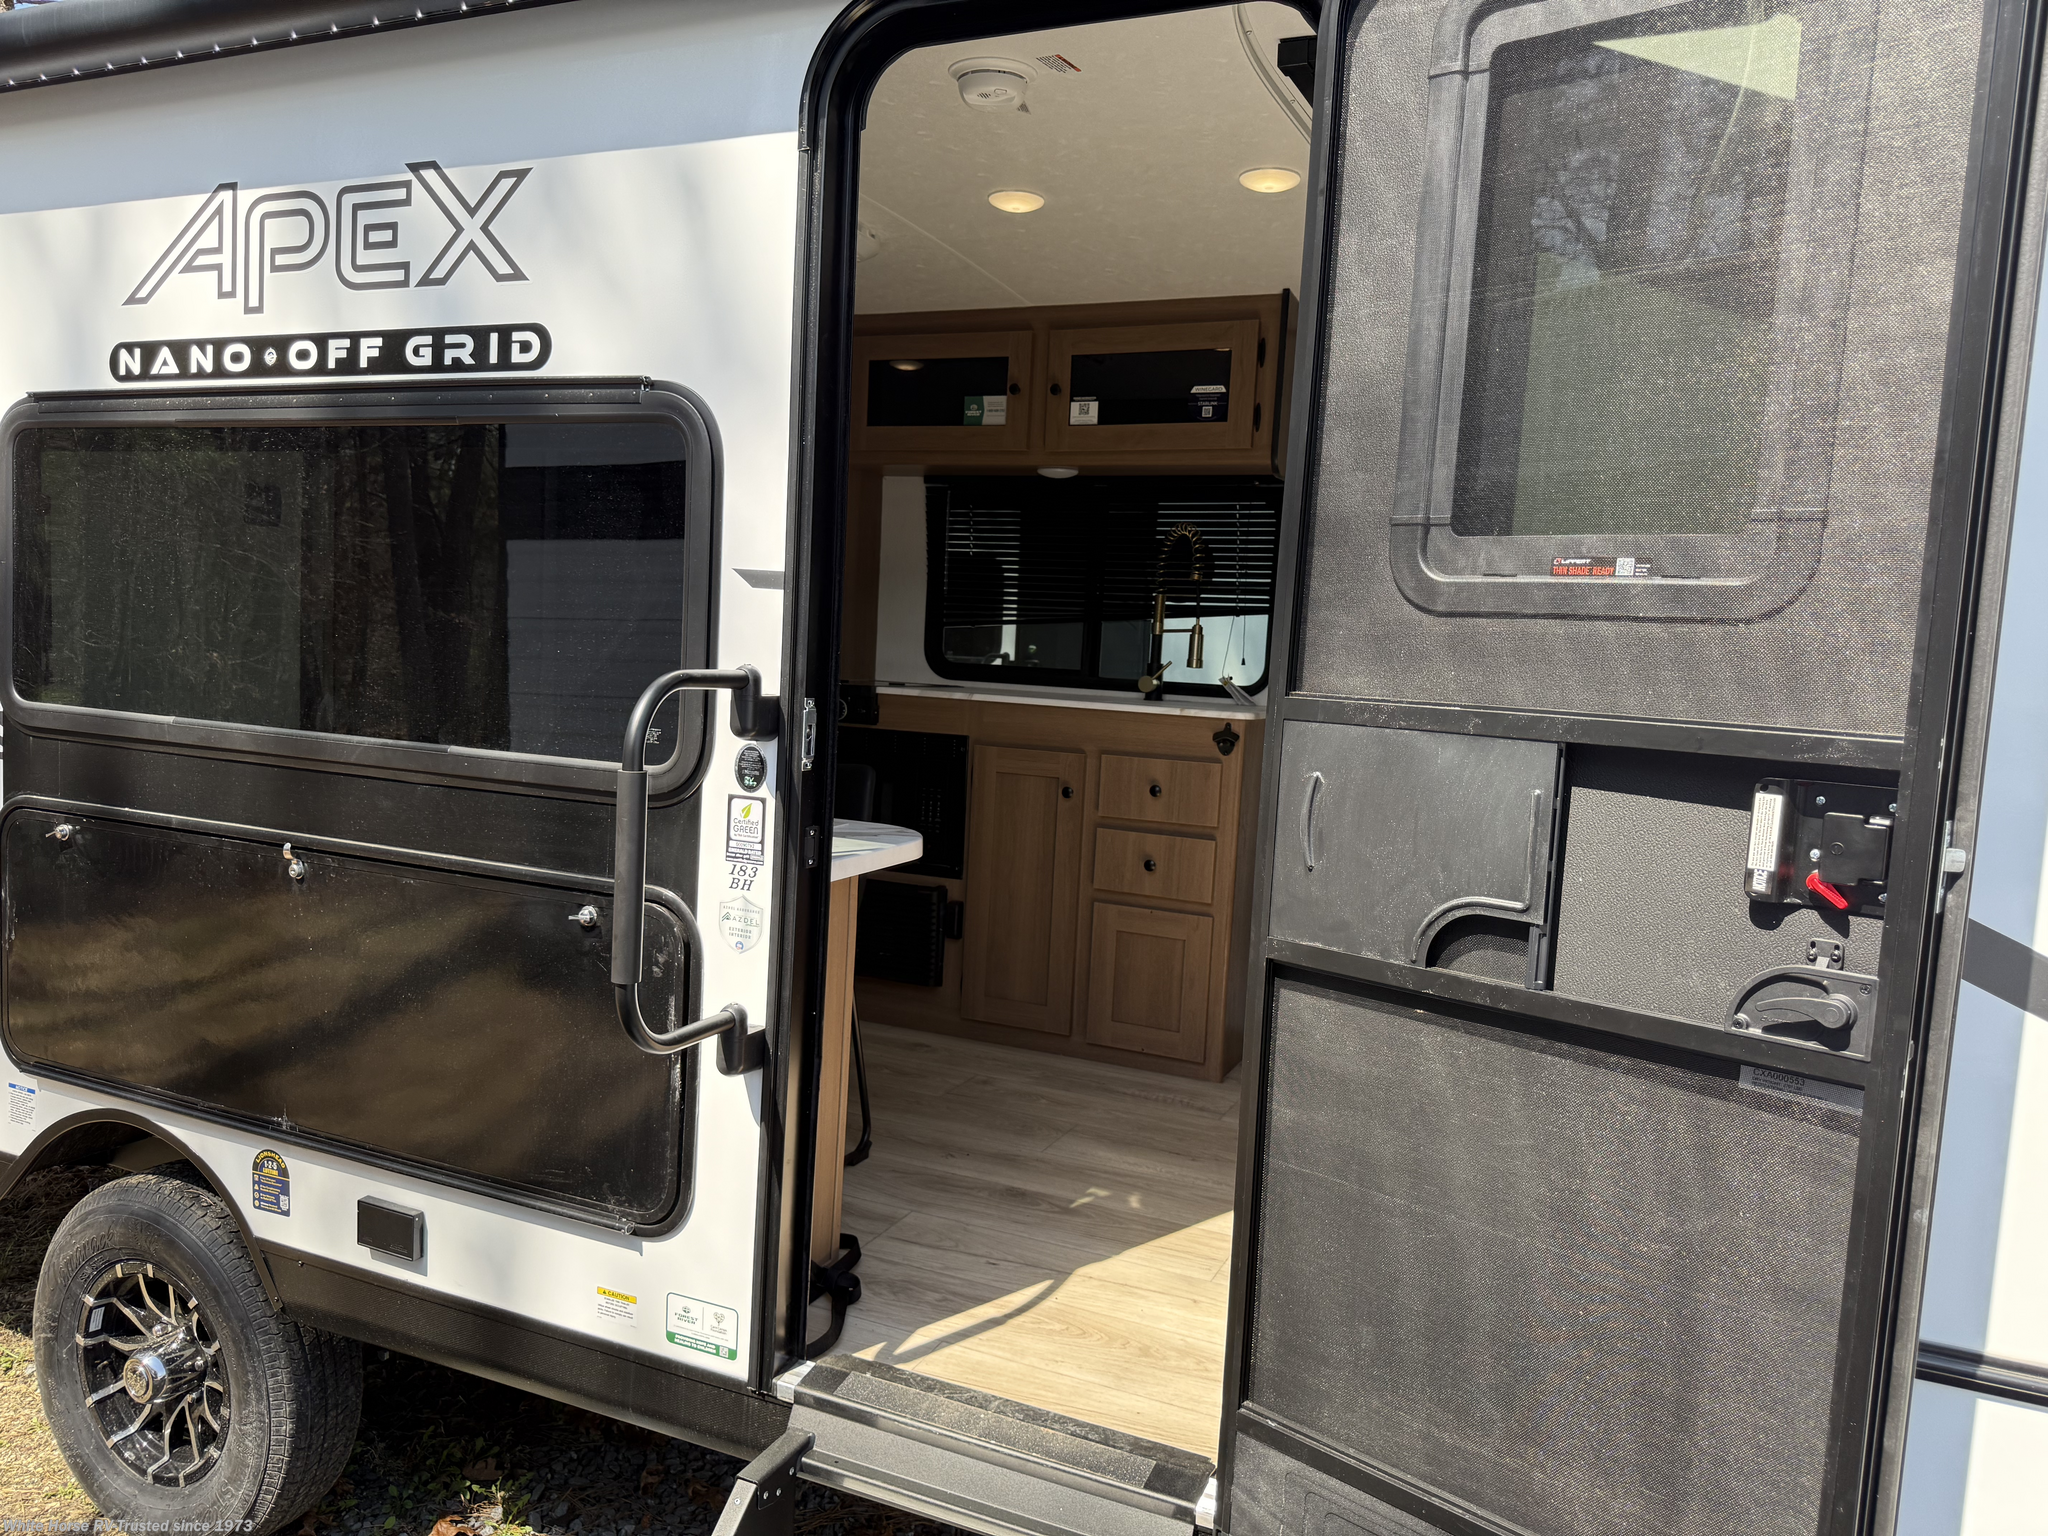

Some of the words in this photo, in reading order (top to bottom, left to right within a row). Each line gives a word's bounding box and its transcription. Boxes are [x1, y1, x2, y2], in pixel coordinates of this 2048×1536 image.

[121, 160, 534, 315] APEX
[118, 343, 252, 376] NANO
[288, 337, 384, 371] OFF
[405, 331, 542, 366] GRID
[1553, 567, 1568, 575] THIN
[1569, 567, 1589, 575] SHADE
[1592, 567, 1615, 575] READY
[733, 817, 759, 827] Certified
[733, 824, 759, 835] GREEN
[729, 864, 758, 879] 183
[729, 877, 754, 891] BH
[732, 916, 760, 926] AZDEL
[255, 1151, 286, 1169] LIONSHEAD
[607, 1290, 630, 1301] CAUTION
[674, 1312, 698, 1321] FOREST
